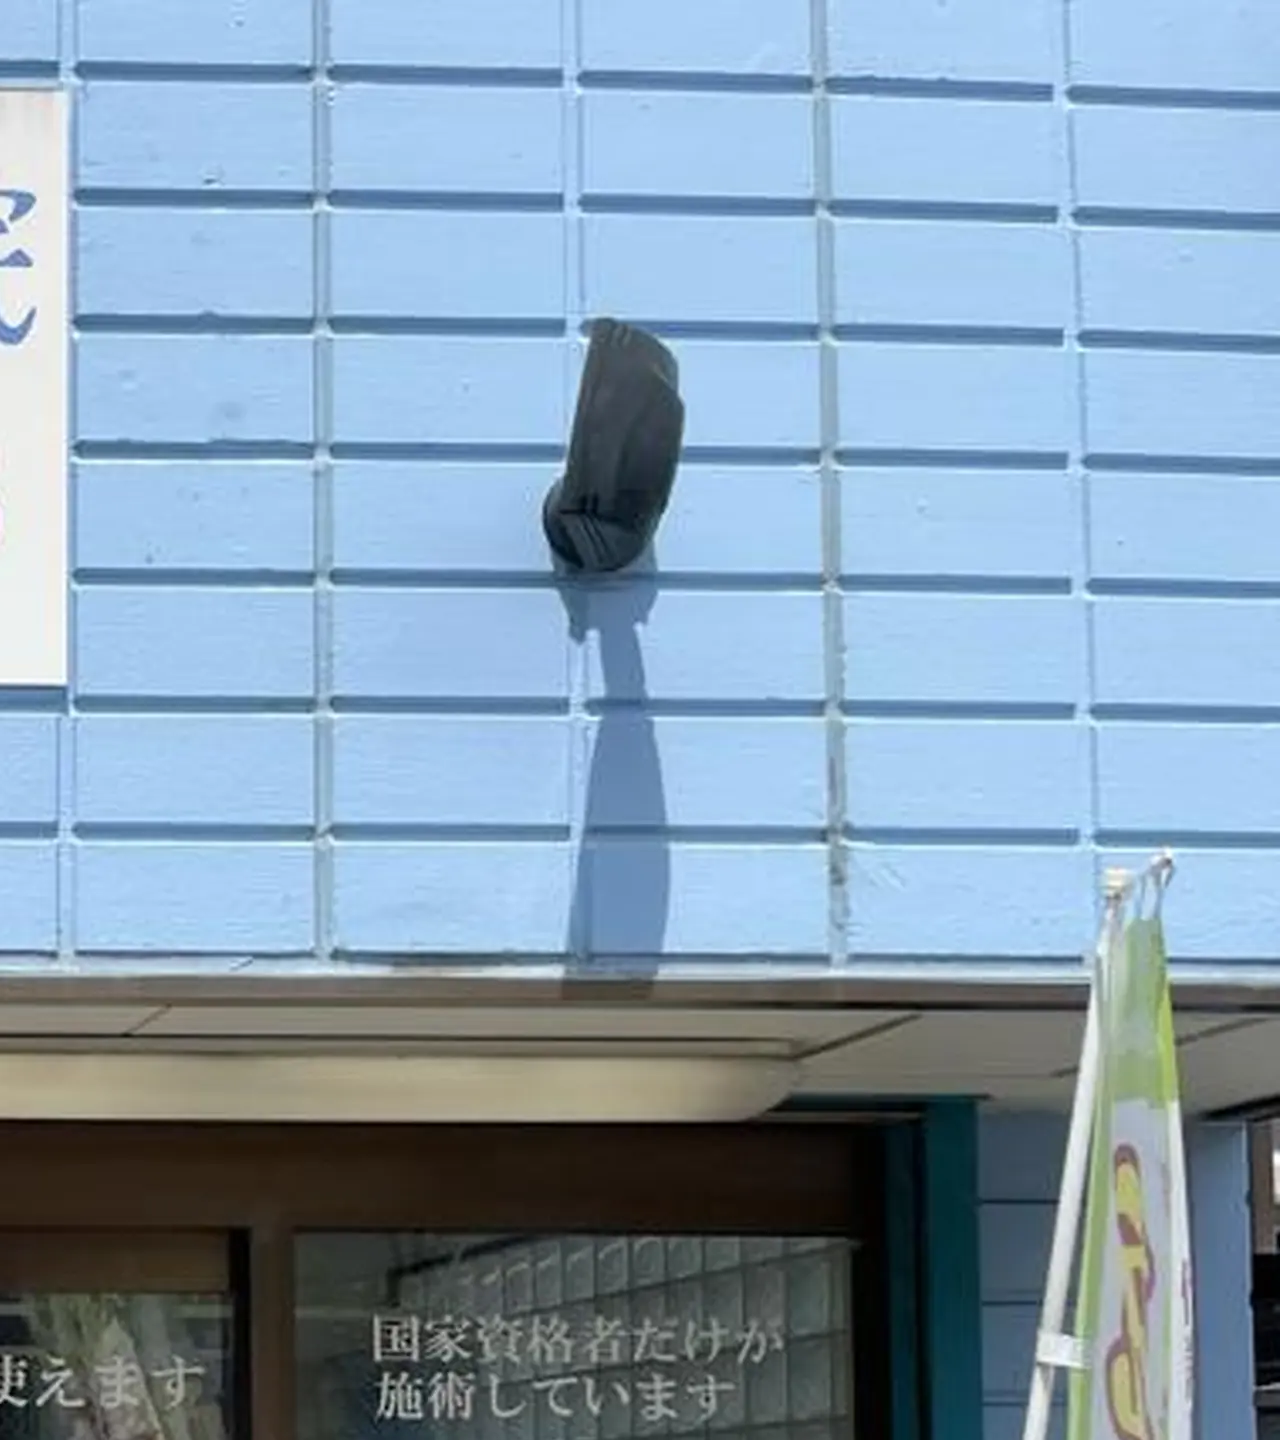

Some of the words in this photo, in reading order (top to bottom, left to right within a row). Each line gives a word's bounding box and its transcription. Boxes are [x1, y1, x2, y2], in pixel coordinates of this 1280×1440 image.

[371, 1313, 785, 1365] 国家資格者だけが
[376, 1371, 737, 1422] 施術しています
